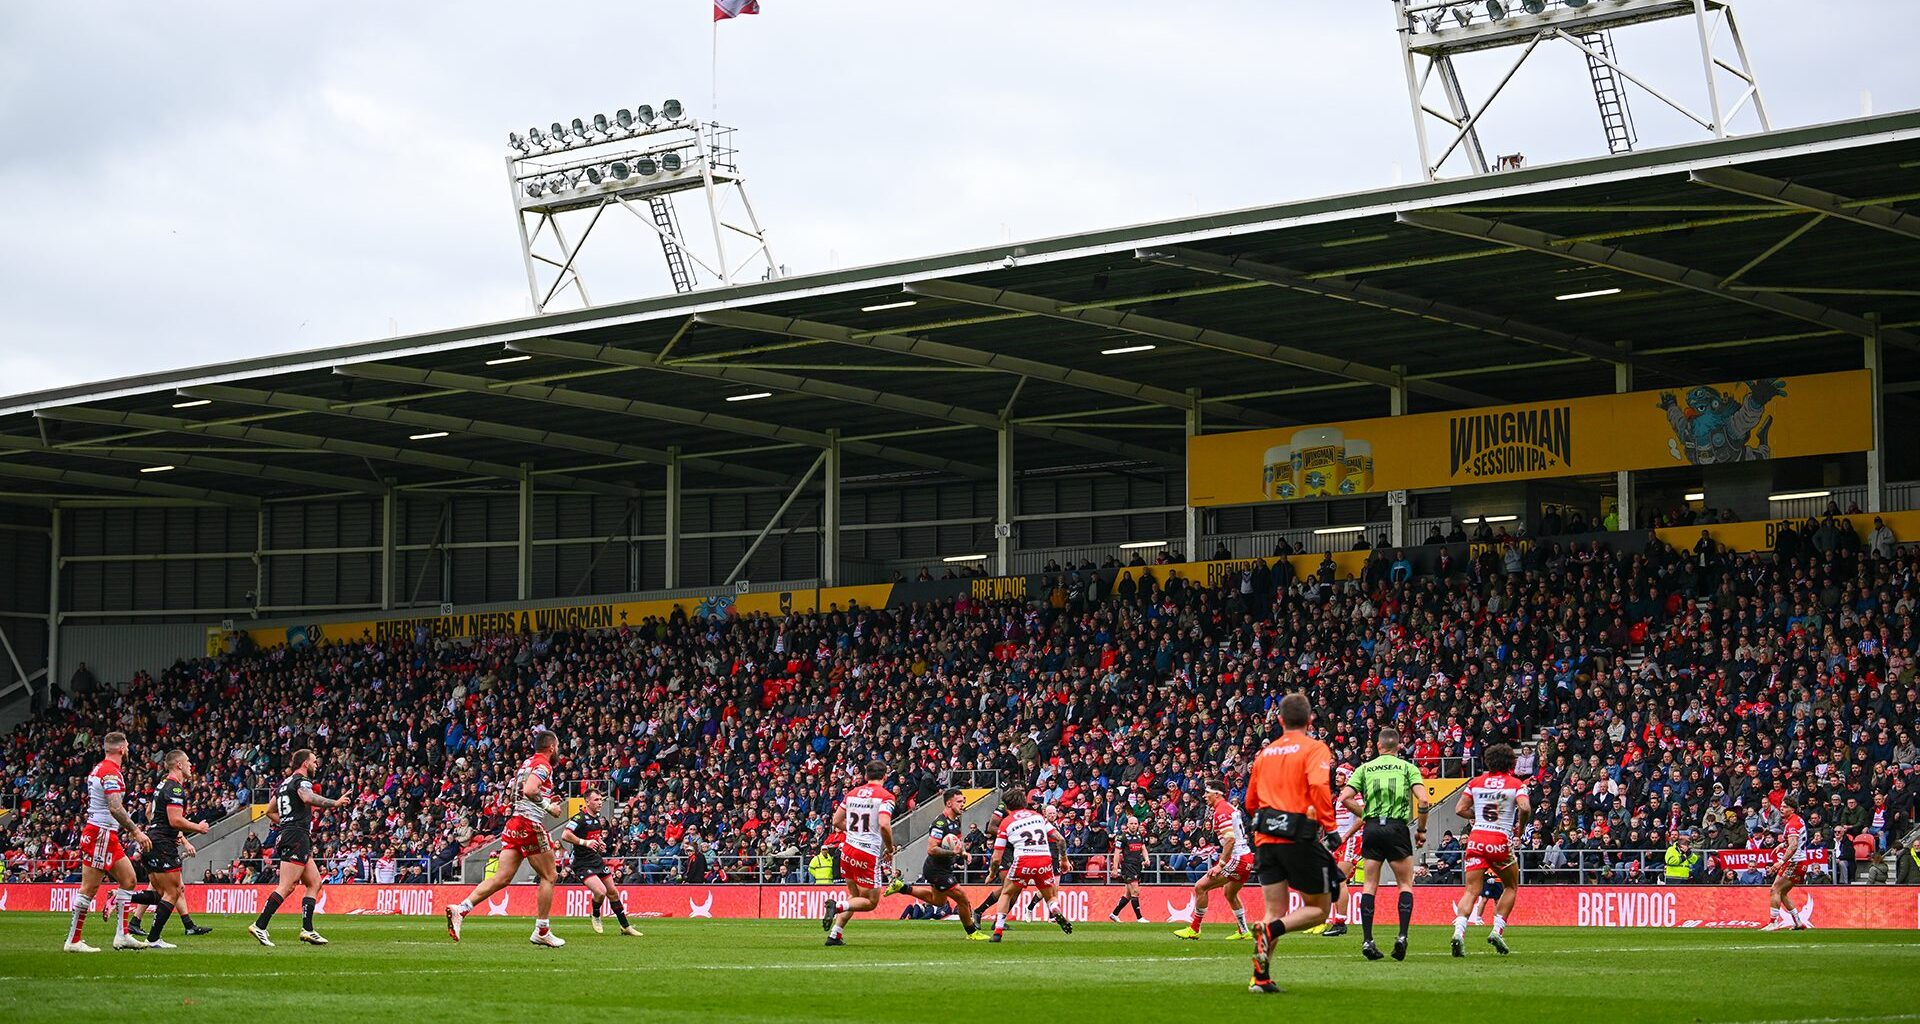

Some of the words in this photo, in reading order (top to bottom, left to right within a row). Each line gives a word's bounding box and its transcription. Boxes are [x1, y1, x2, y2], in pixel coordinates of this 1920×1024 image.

[1450, 407, 1570, 477] WINGMAN
[1473, 446, 1525, 477] SESSION
[1527, 446, 1547, 472] IPA
[1390, 492, 1403, 503] NE
[997, 525, 1008, 536] ND
[1469, 540, 1533, 562] BRWO
[737, 582, 748, 592] NC
[972, 576, 1027, 600] BREWDOG
[442, 604, 451, 614] NB
[422, 616, 464, 639] EAM
[469, 612, 515, 636] NEEDS
[520, 611, 531, 634] A
[535, 605, 613, 631] WINGMAN
[1264, 744, 1300, 757] PHYSIO
[1366, 763, 1403, 772] RONSEAL
[277, 795, 292, 817] 13
[1482, 803, 1498, 822] 6
[849, 812, 870, 832] 21
[1019, 829, 1047, 846] 22
[1723, 853, 1773, 865] WIRRAL
[1777, 848, 1824, 862] STS
[50, 887, 97, 912] BREW
[206, 889, 258, 913] BREWDOG
[376, 889, 433, 916] BREWDOG
[566, 890, 629, 917] BREDG
[1578, 892, 1677, 927] BREWDOG
